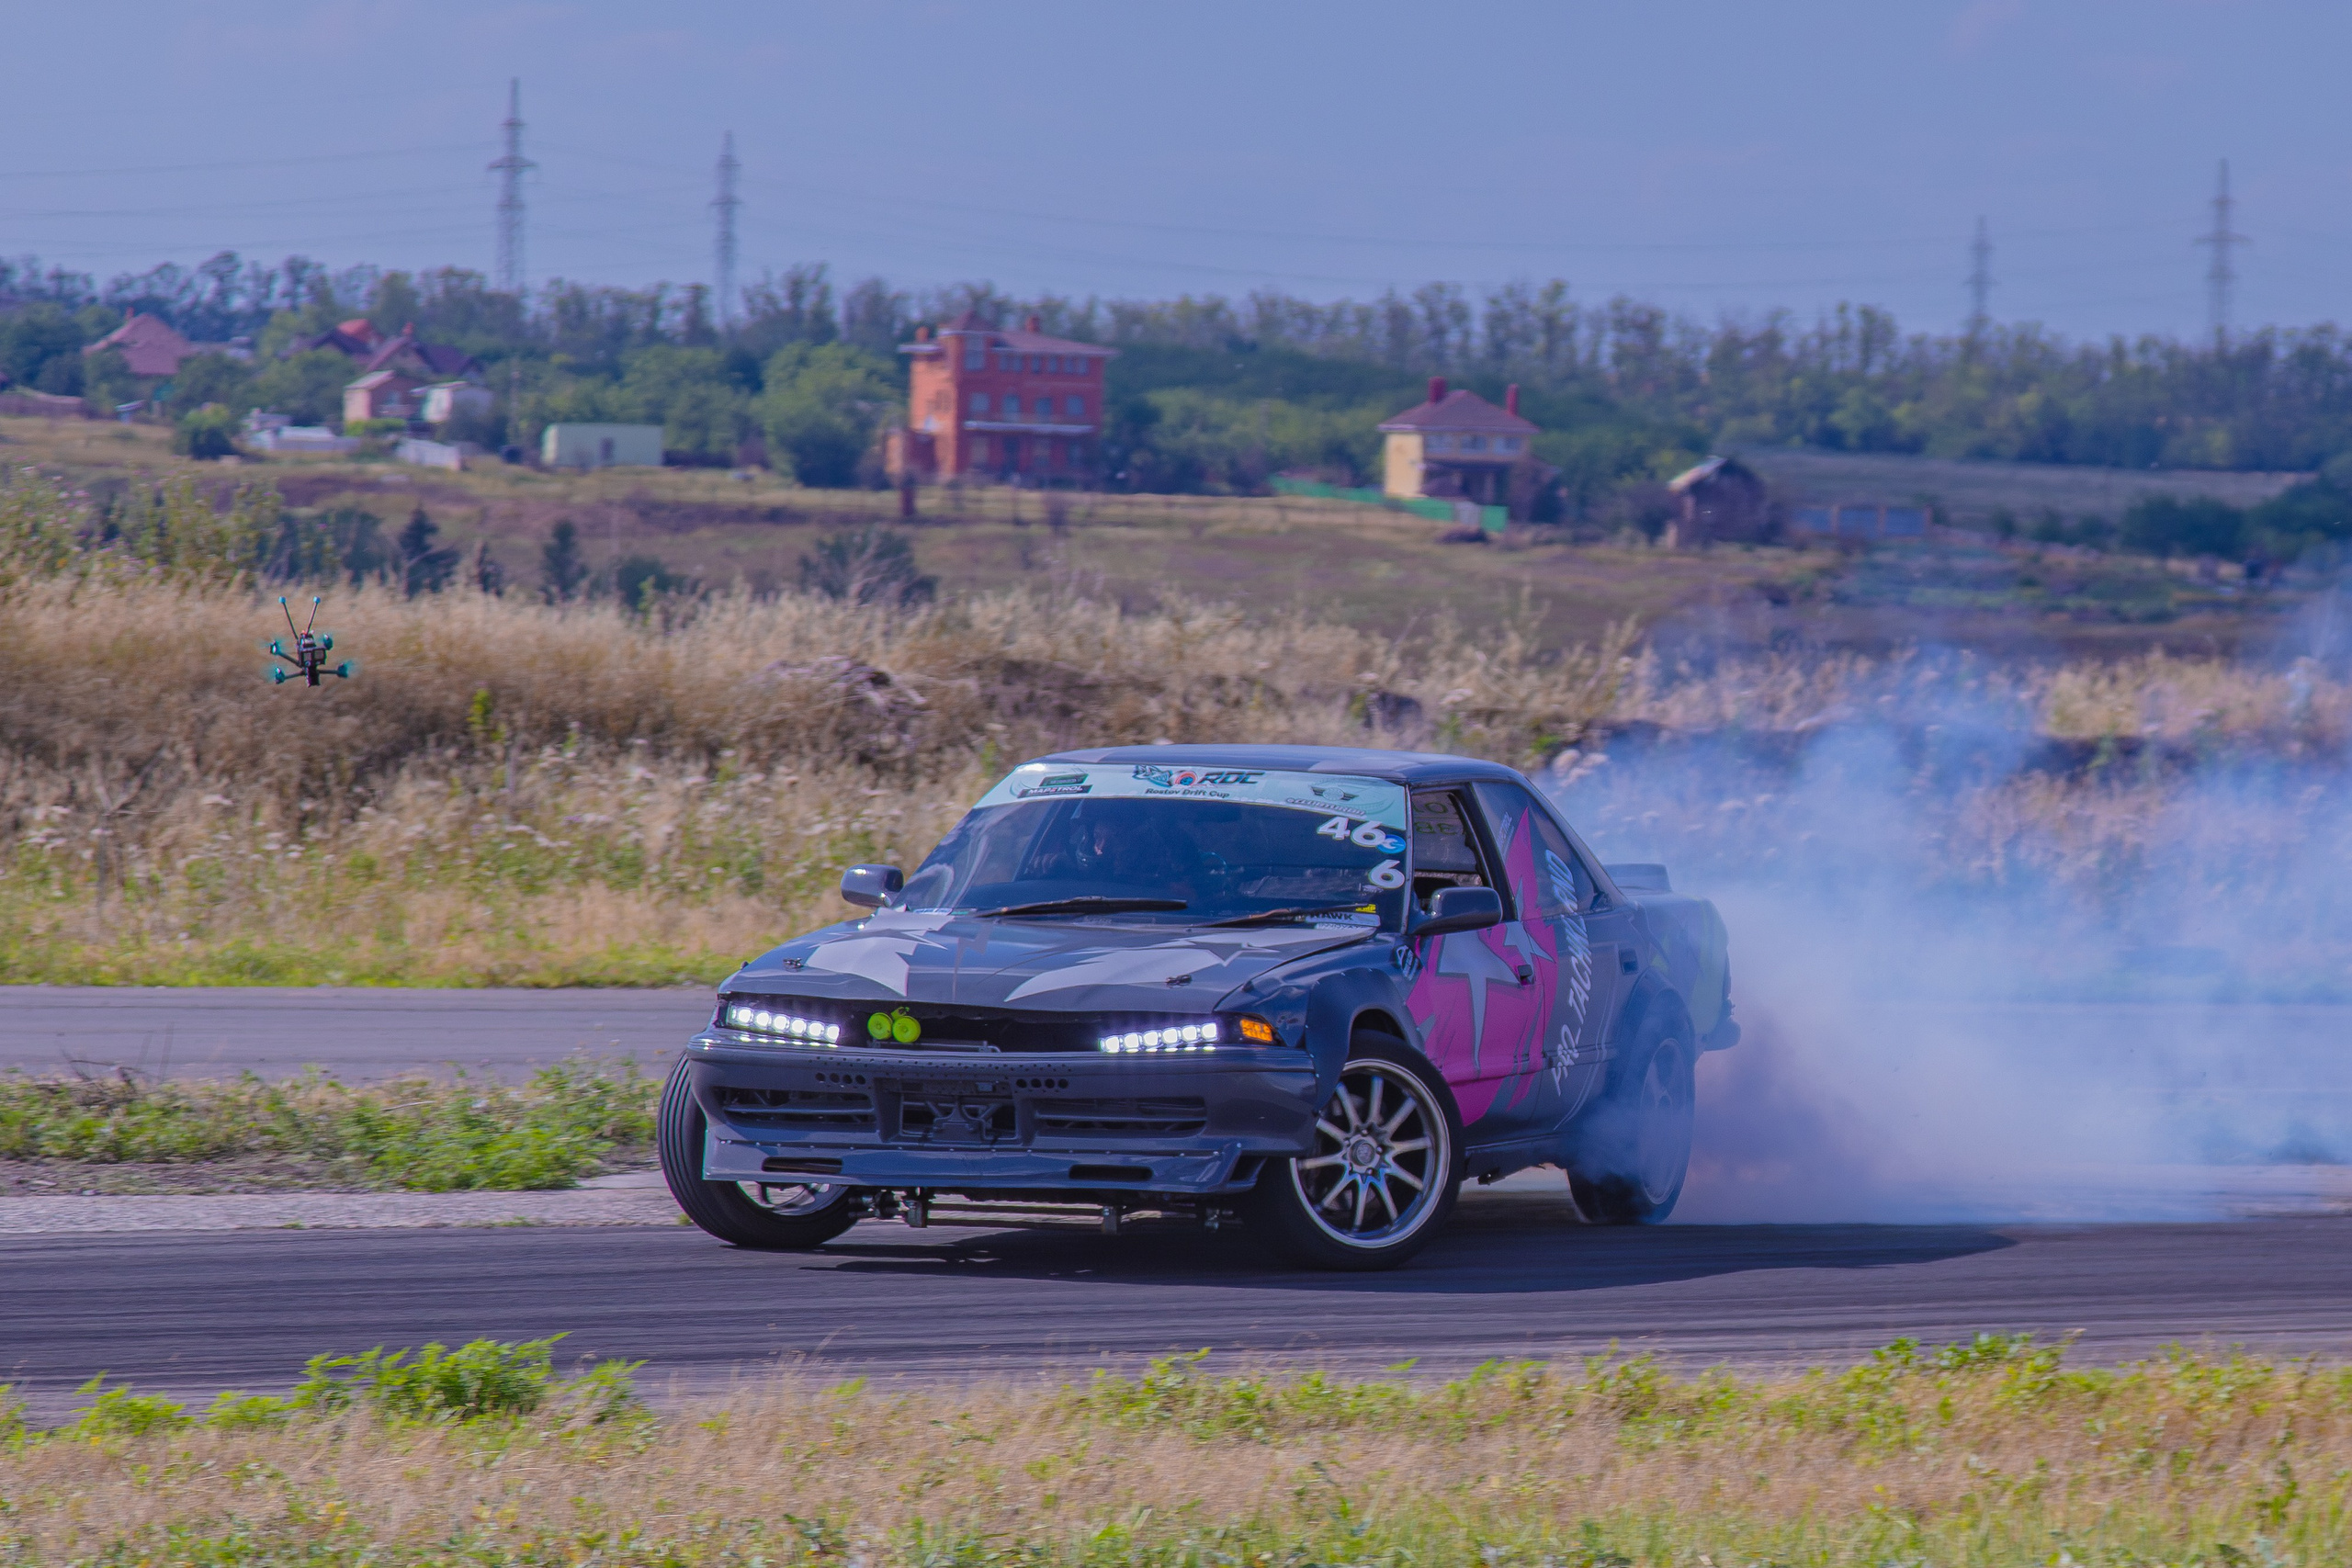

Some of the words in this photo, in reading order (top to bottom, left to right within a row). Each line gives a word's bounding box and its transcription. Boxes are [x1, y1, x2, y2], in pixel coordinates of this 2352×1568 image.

[1145, 787, 1181, 795] Rostov
[1182, 788, 1207, 797] Drift
[1209, 790, 1229, 799] Cup
[1317, 816, 1386, 848] 46
[1369, 859, 1404, 890] 6
